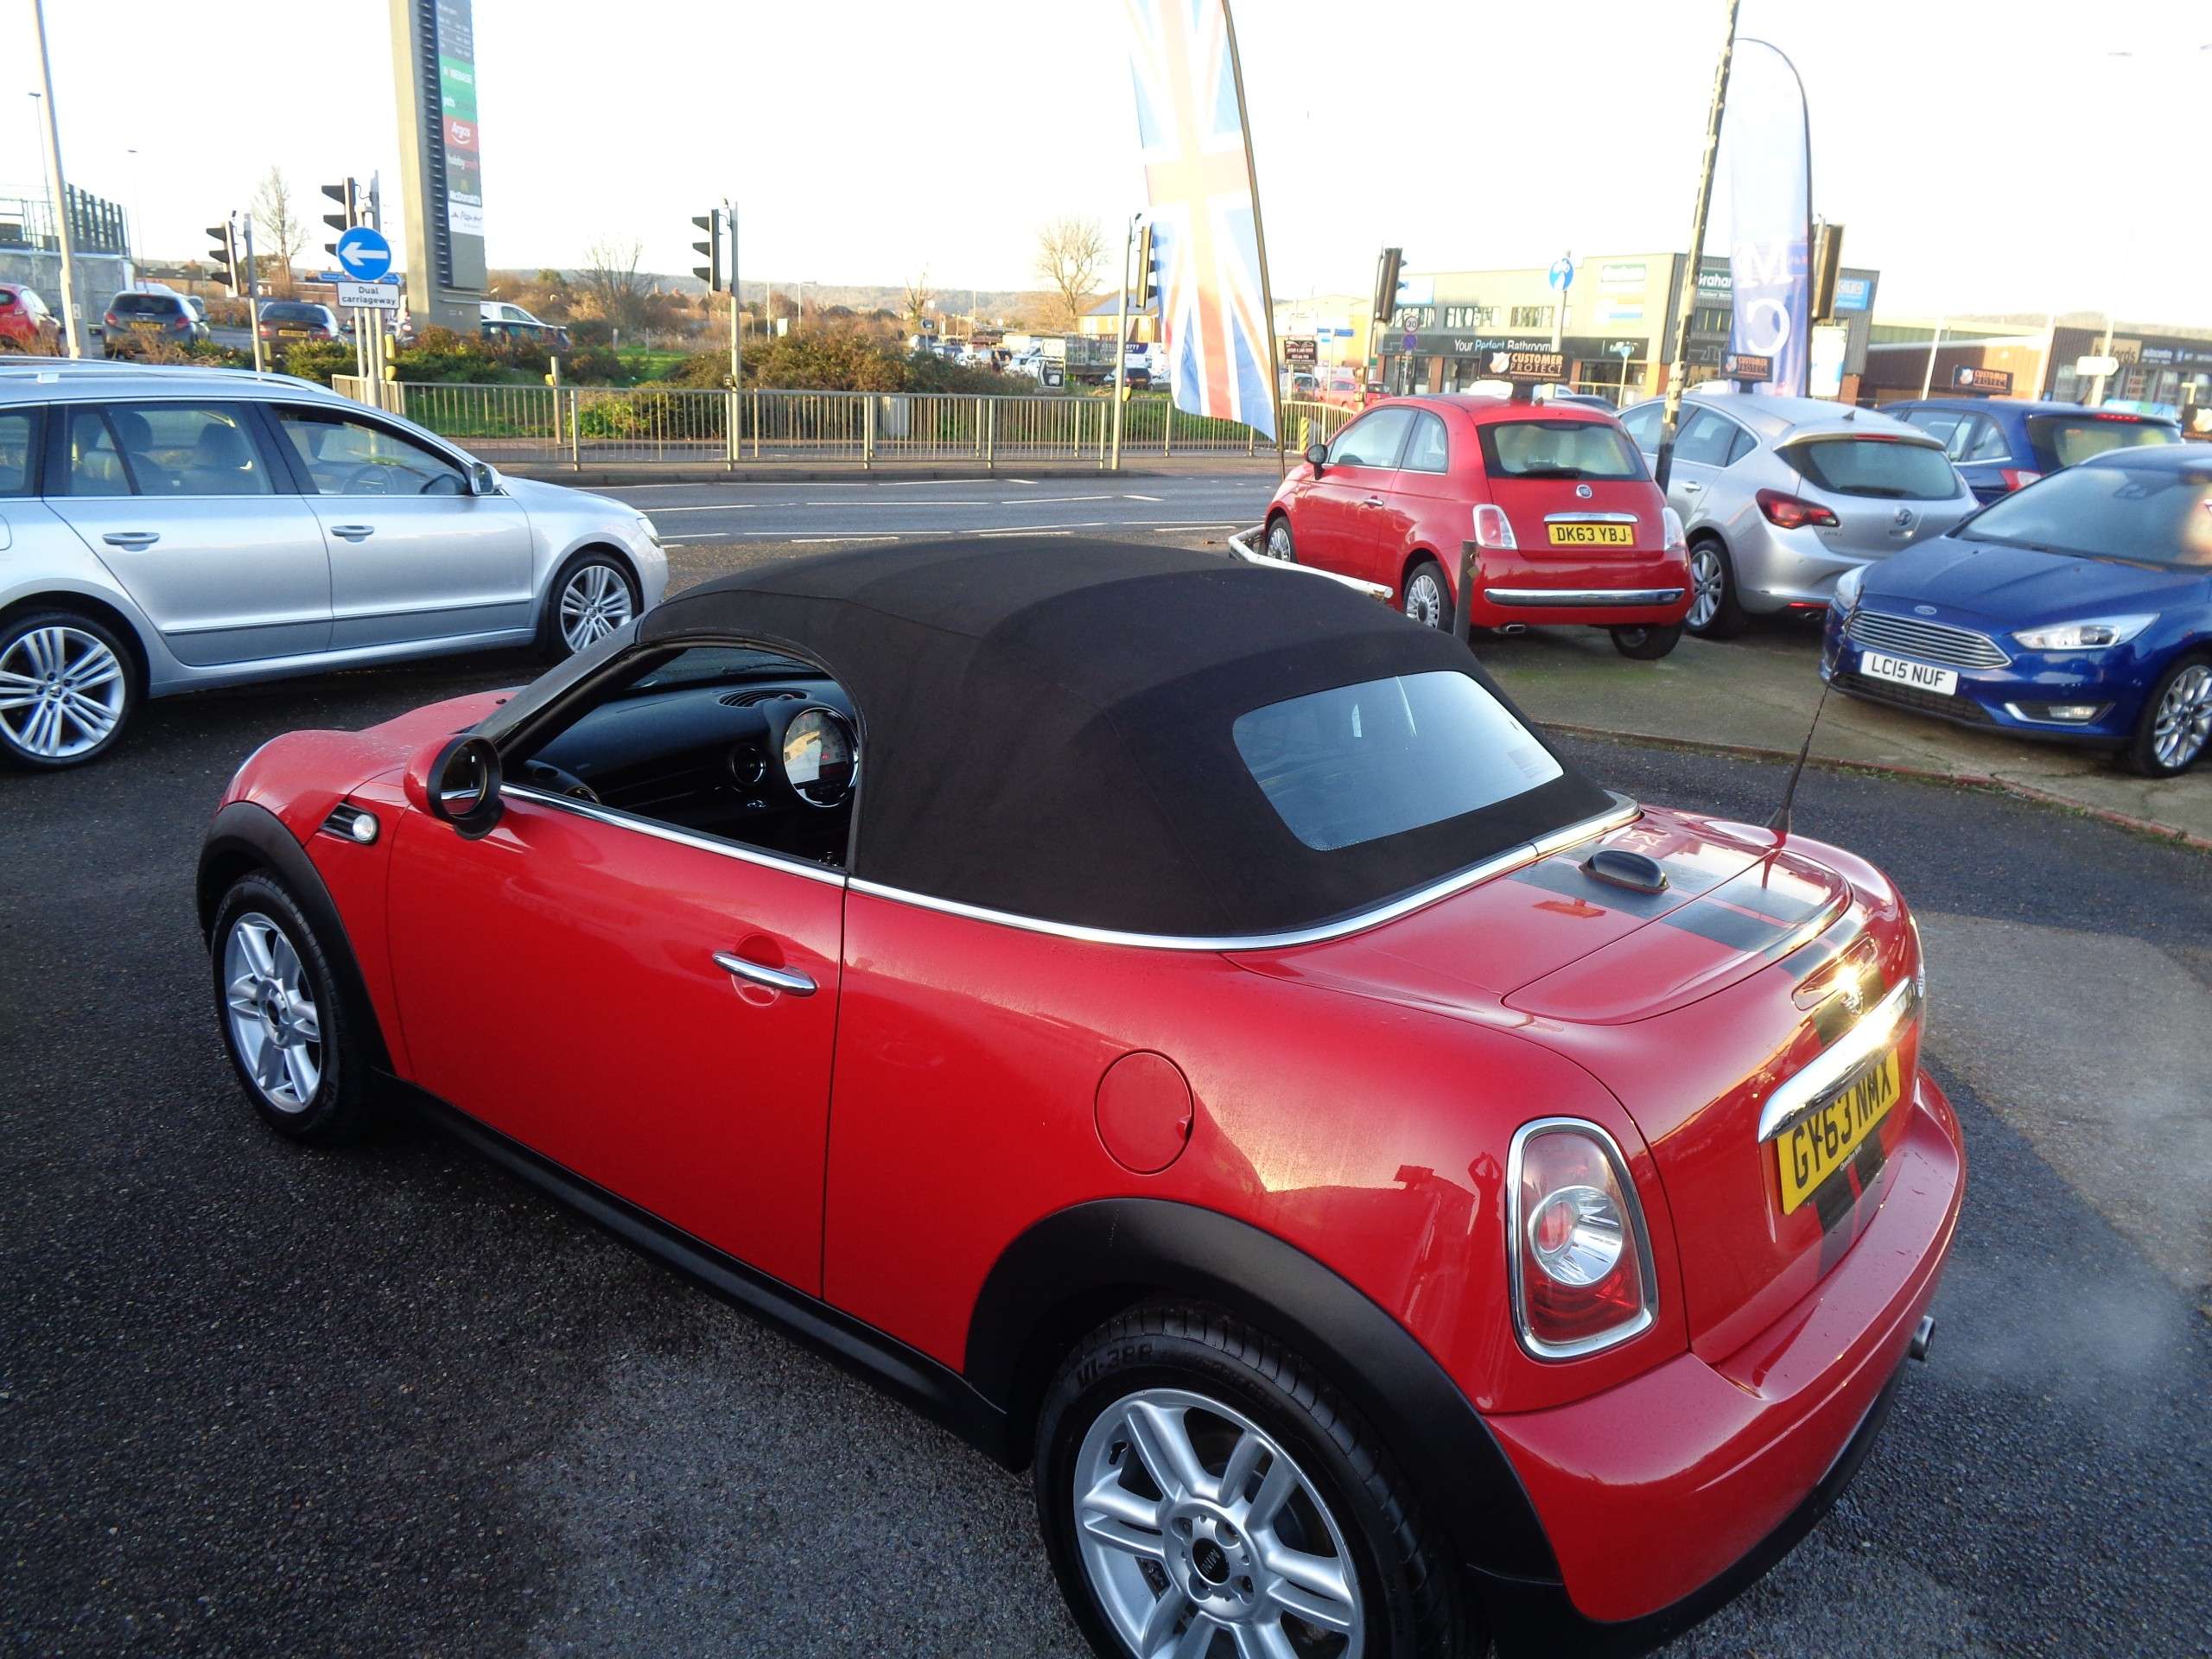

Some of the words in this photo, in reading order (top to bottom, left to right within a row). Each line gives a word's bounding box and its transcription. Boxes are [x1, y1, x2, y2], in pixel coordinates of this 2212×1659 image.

[359, 286, 378, 295] Dual
[341, 296, 396, 305] carriageway
[1454, 339, 1474, 352] Your
[1475, 340, 1505, 352] Perfect
[1511, 353, 1563, 365] CUSTOMER
[1510, 363, 1562, 373] PROTECT
[1556, 527, 1595, 541] DK63
[1599, 528, 1627, 542] YBJ
[1872, 655, 1907, 678] LC15
[1911, 664, 1946, 687] NUF
[1792, 1091, 1853, 1189] GY63
[1857, 1059, 1892, 1130] NMX
